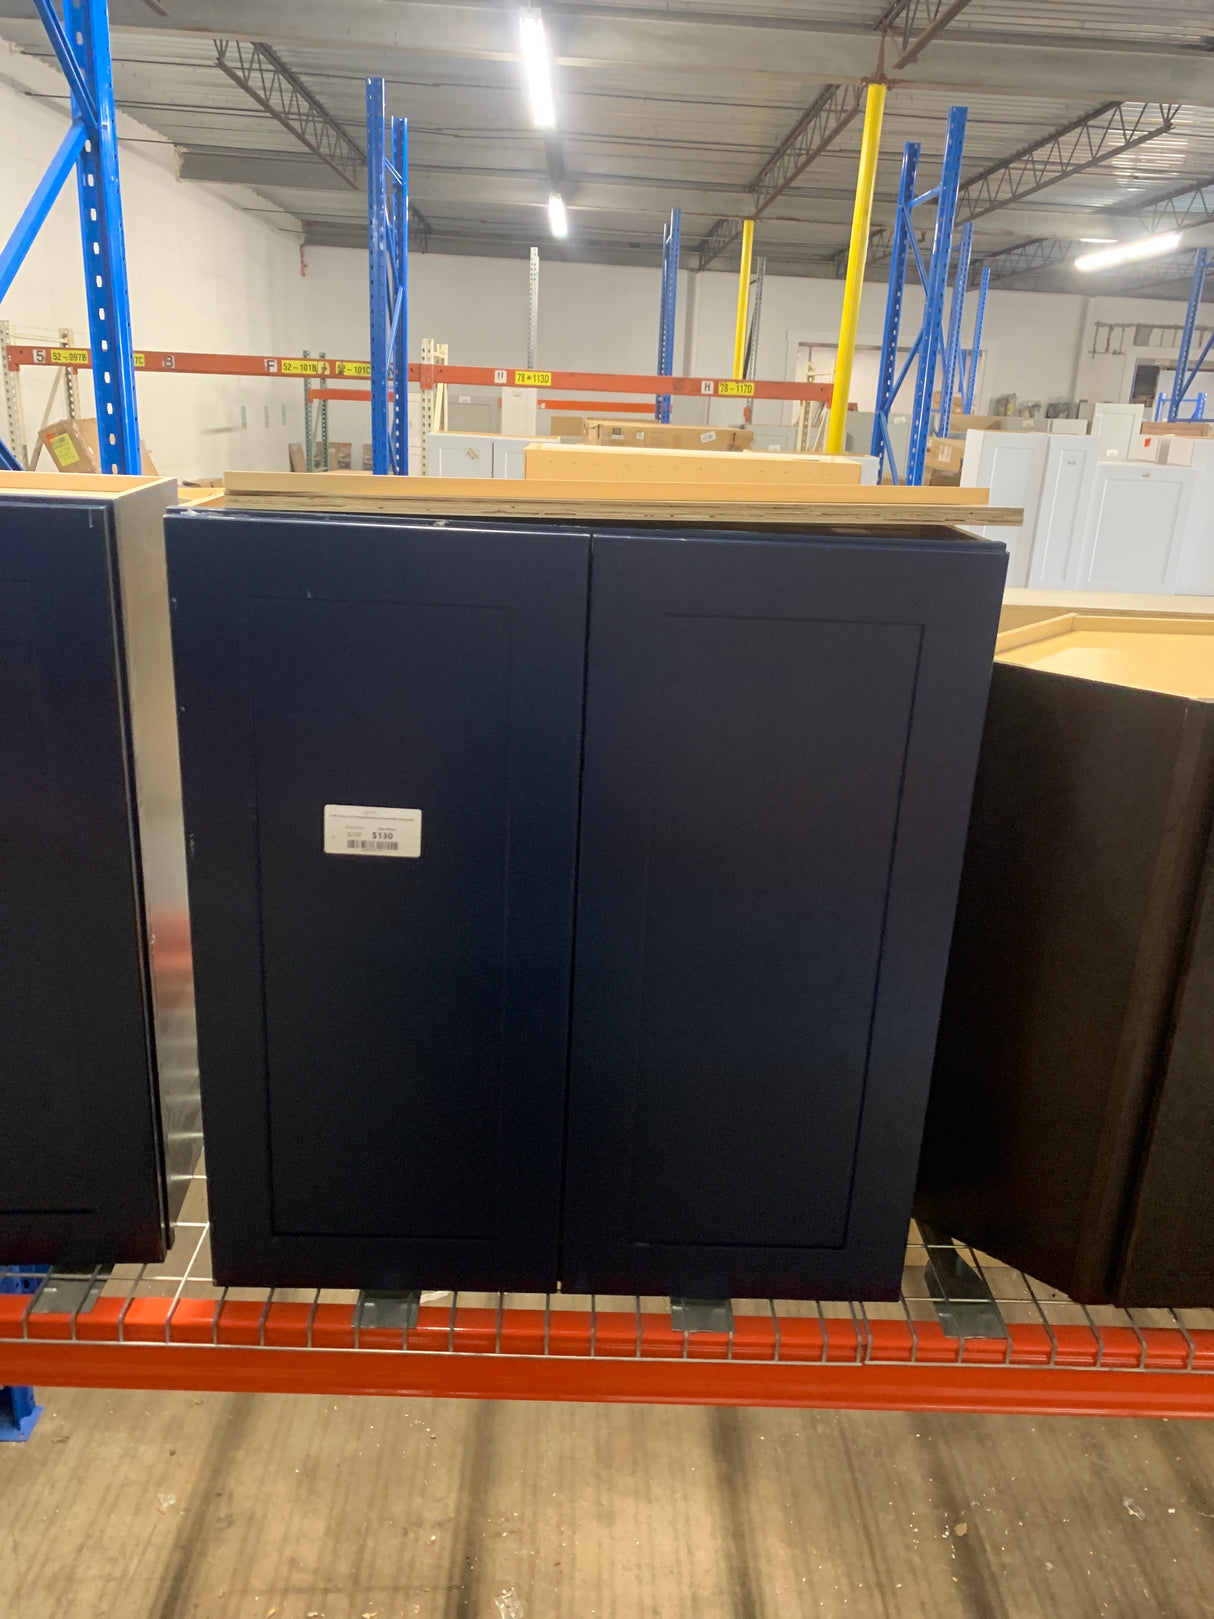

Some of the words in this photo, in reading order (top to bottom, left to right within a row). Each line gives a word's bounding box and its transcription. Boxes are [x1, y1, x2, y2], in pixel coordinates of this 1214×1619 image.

[36, 350, 44, 362] 5
[266, 360, 275, 371] F
[704, 382, 711, 391] H
[372, 831, 393, 839] $130
